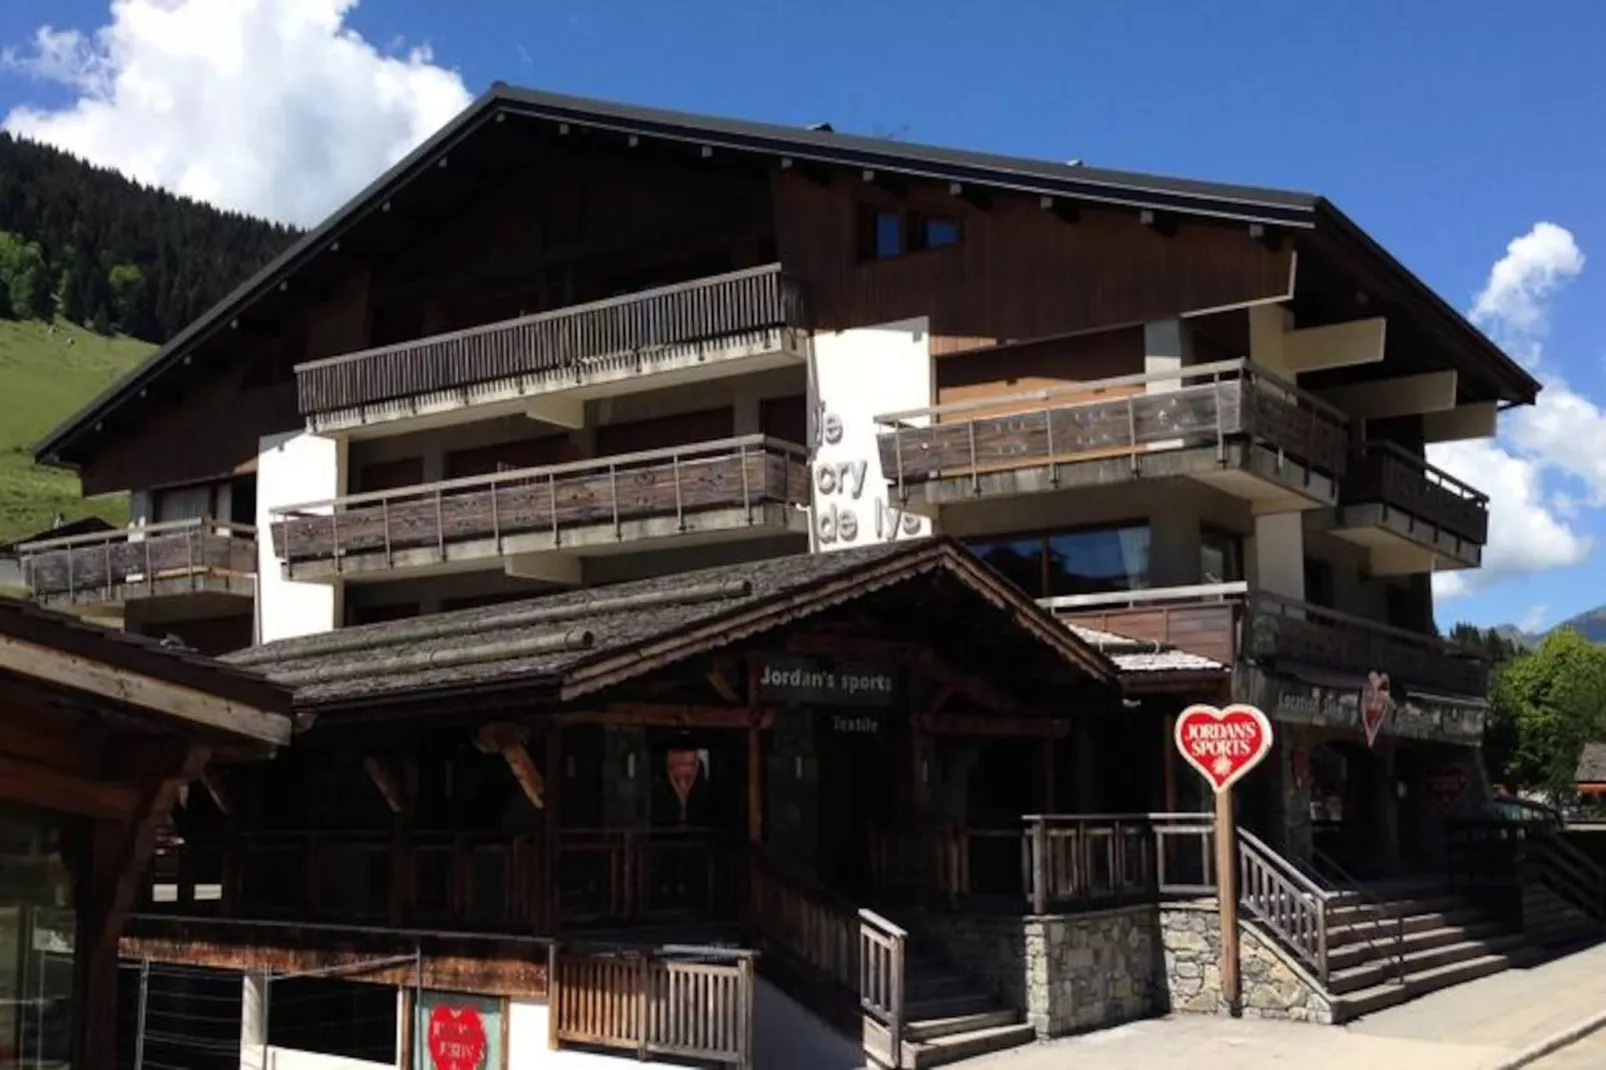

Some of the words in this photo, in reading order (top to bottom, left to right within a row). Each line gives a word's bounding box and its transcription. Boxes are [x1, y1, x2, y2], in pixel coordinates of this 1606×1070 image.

[817, 503, 859, 544] de
[760, 666, 834, 688] Jordan's
[841, 674, 893, 694] sports
[1191, 740, 1250, 756] SPORTS
